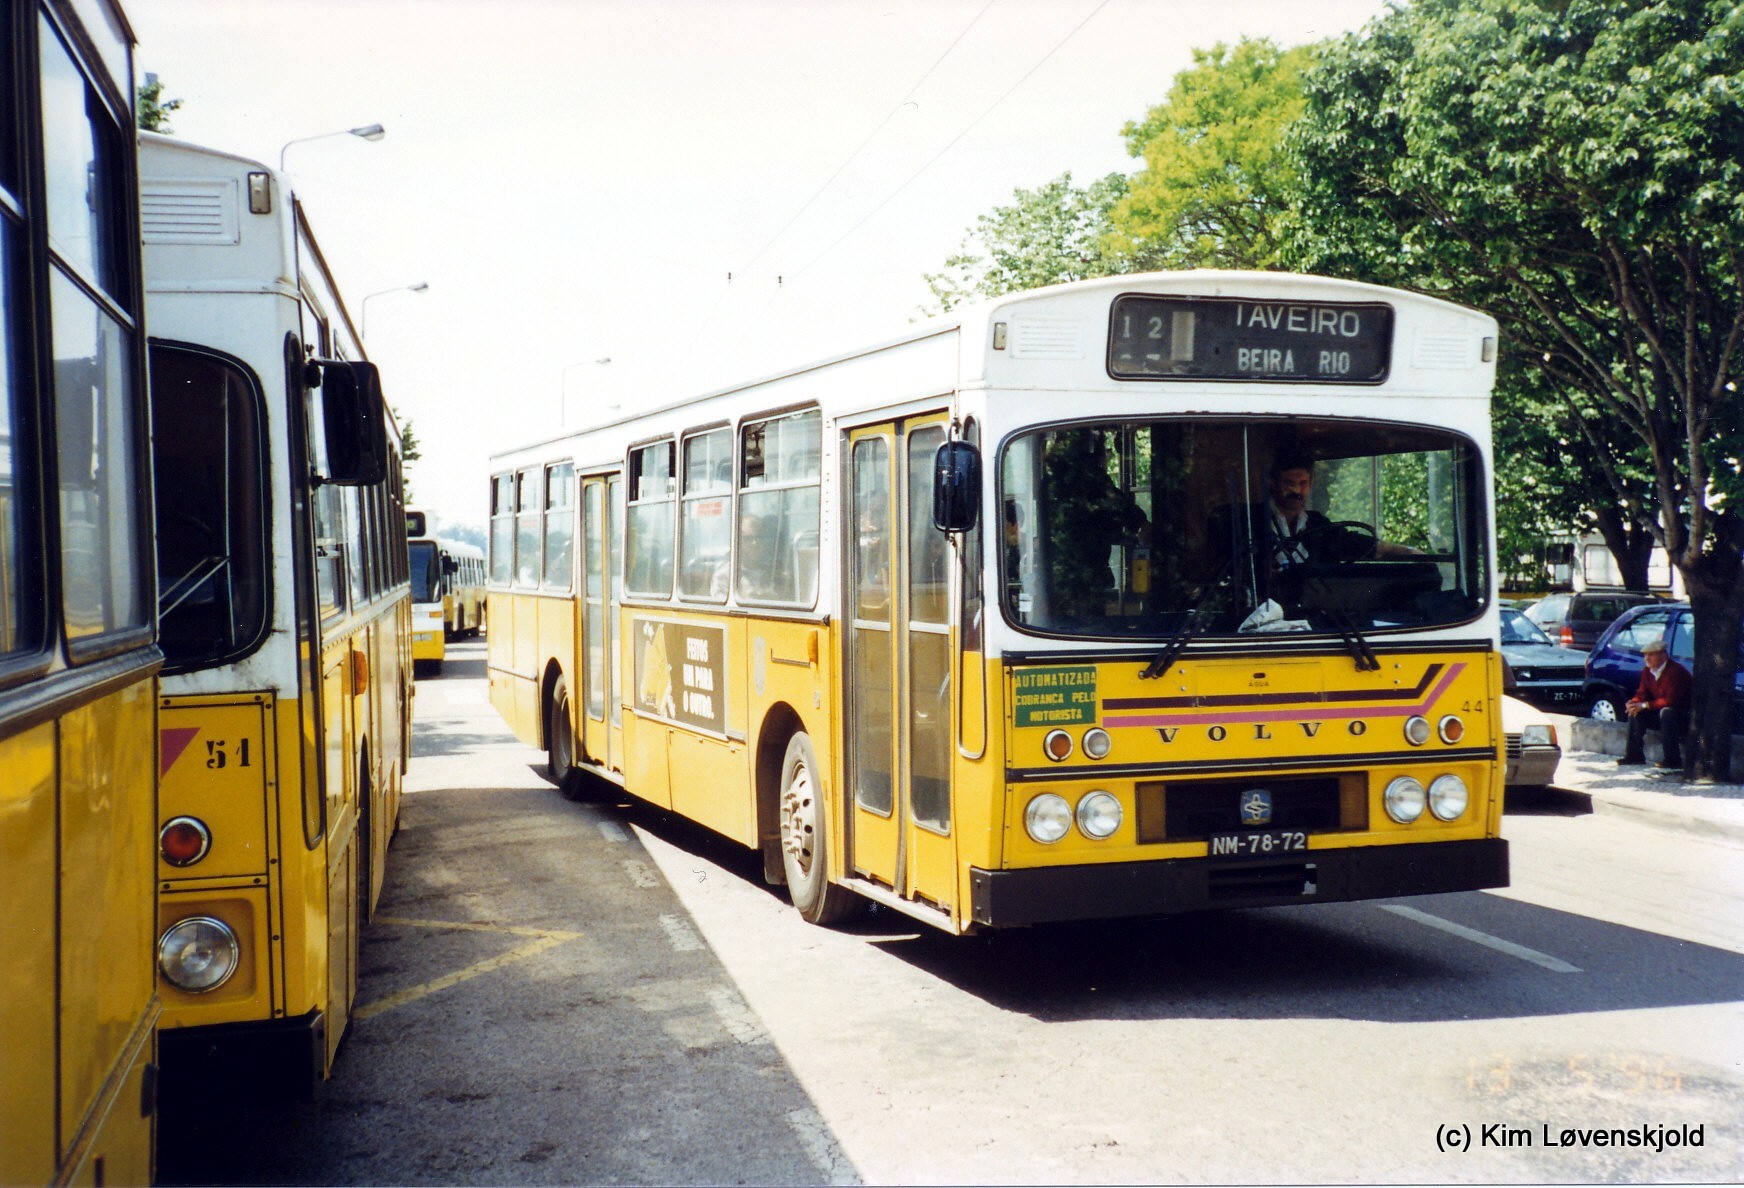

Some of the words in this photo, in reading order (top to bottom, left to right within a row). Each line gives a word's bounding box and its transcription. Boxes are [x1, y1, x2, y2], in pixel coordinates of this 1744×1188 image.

[1237, 347, 1295, 373] BEIRA
[1318, 350, 1351, 374] RIO
[1030, 708, 1083, 721] MOTORISTA
[1462, 700, 1483, 713] 44
[1155, 719, 1367, 744] VOLVO
[206, 738, 251, 769] 51
[1212, 832, 1306, 855] NM-78-72
